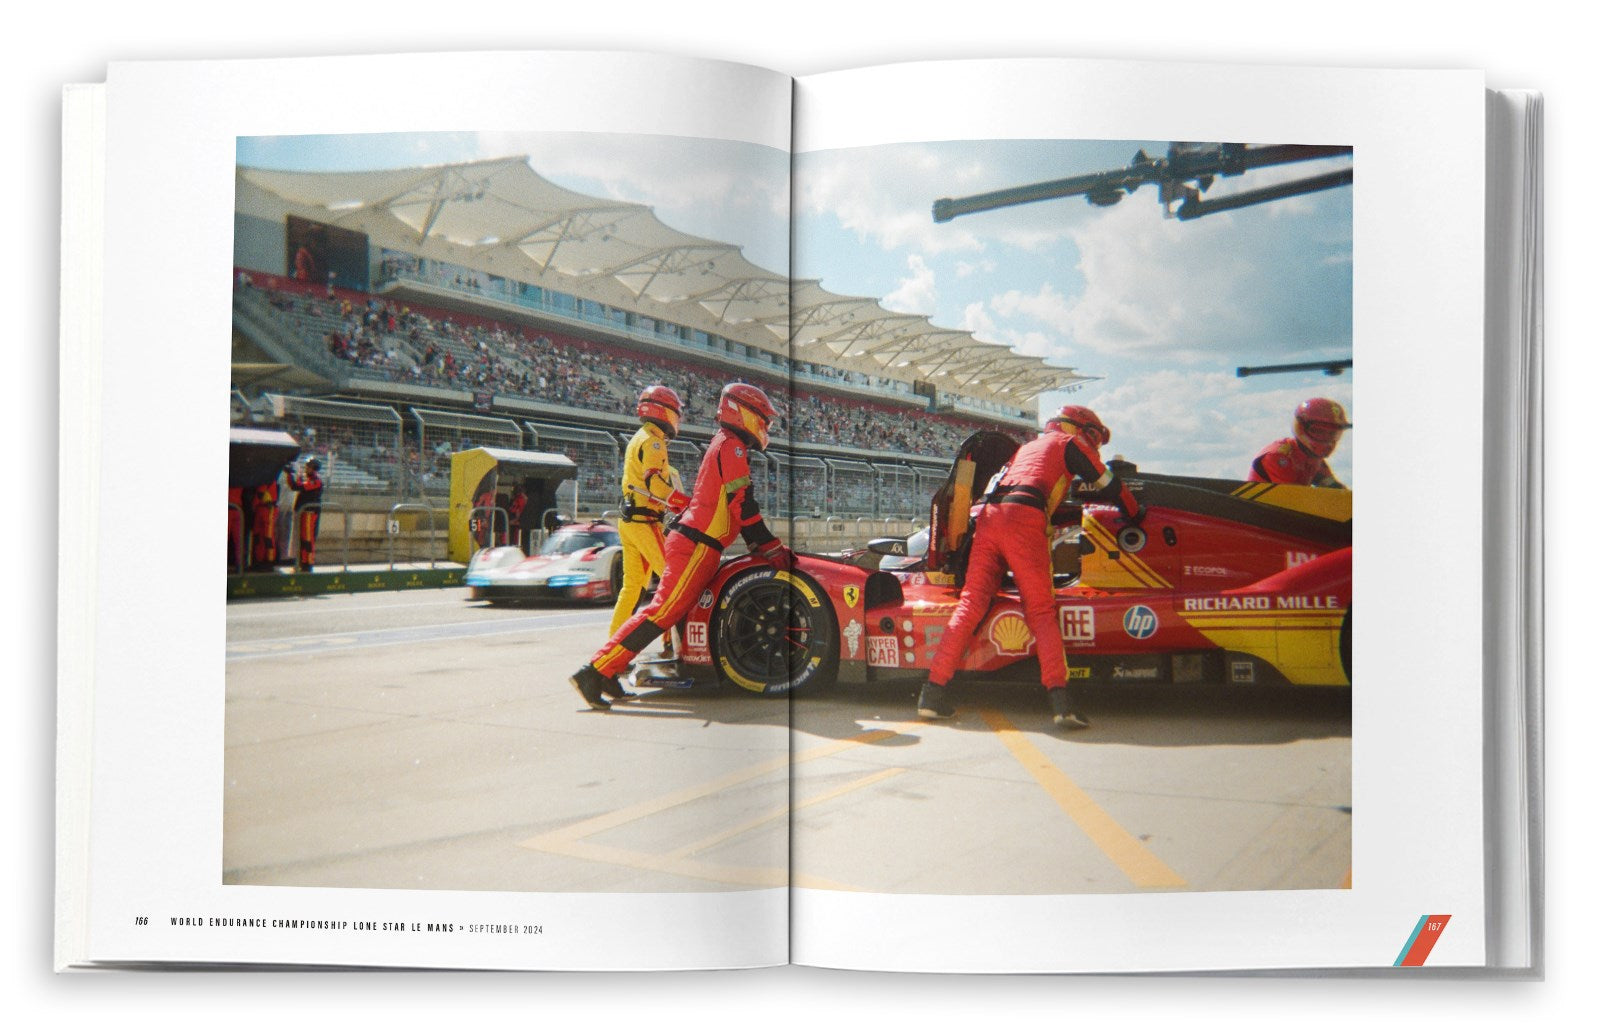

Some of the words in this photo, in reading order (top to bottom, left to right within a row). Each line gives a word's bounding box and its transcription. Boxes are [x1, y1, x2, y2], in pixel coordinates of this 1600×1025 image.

[729, 570, 772, 596] MICHELIN
[1184, 597, 1270, 611] RICHARD
[1277, 596, 1338, 609] MILLE
[1128, 605, 1154, 639] hp
[868, 637, 897, 649] HYPER
[868, 648, 898, 665] CAR
[135, 916, 149, 926] 166
[170, 917, 204, 926] WORLD
[209, 917, 267, 927] ENDURANCE
[272, 919, 348, 930] CHAMPIONSHIP
[353, 921, 377, 930] LONE
[382, 922, 405, 931] STAR
[411, 922, 421, 931] LE
[427, 923, 454, 932] MANS
[469, 924, 519, 933] SEPTEMBER
[523, 925, 543, 934] 2024
[1428, 922, 1442, 931] 167
